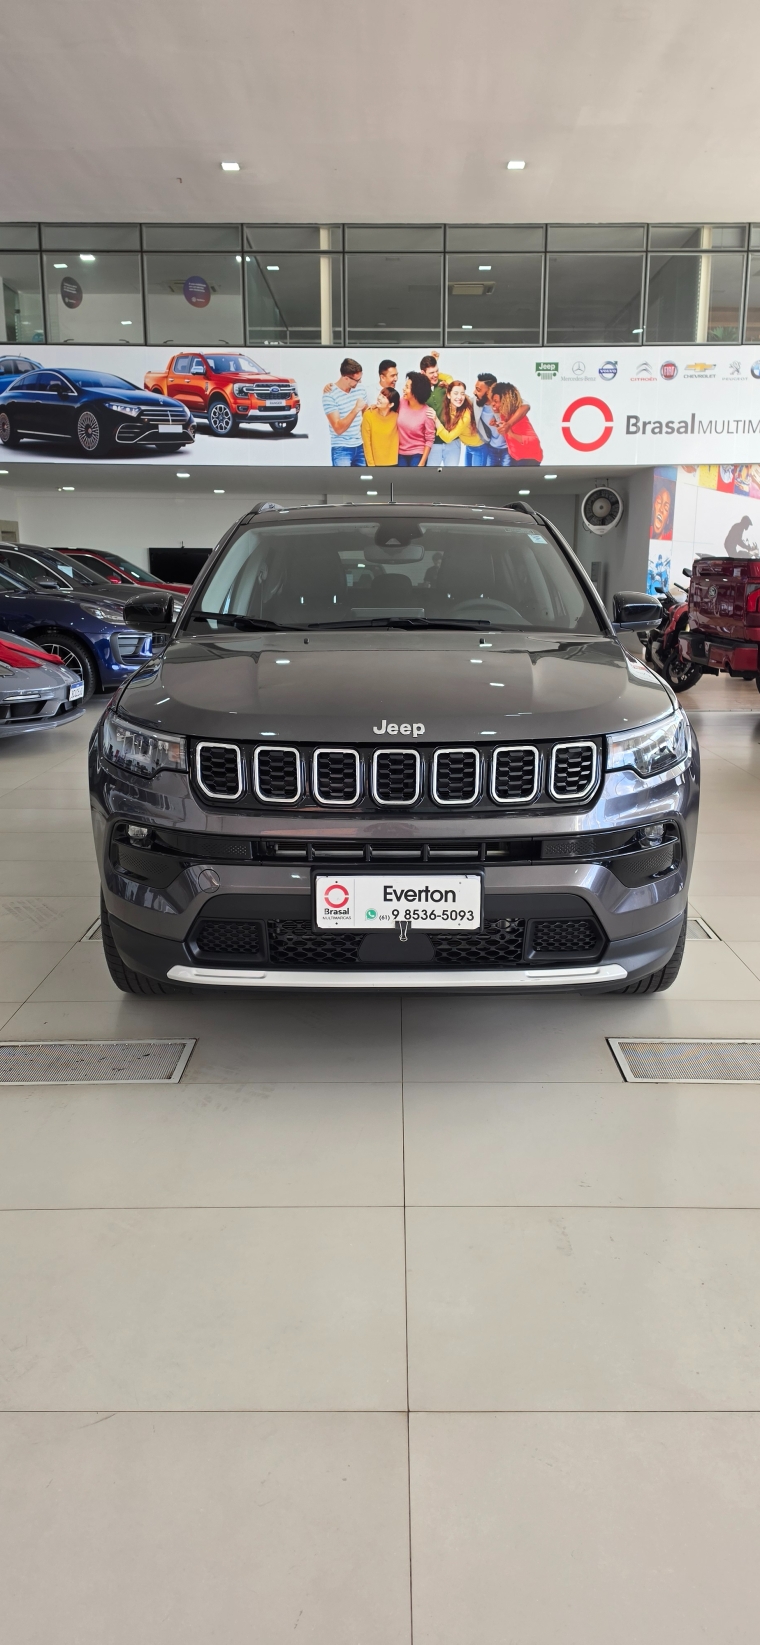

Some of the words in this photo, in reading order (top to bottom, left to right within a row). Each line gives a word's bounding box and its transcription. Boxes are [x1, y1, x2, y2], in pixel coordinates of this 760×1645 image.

[625, 413, 696, 435] Brasal
[372, 719, 426, 738] Jeep
[383, 885, 456, 903] Everton
[392, 909, 400, 920] 9
[404, 909, 474, 921] 8536-5093
